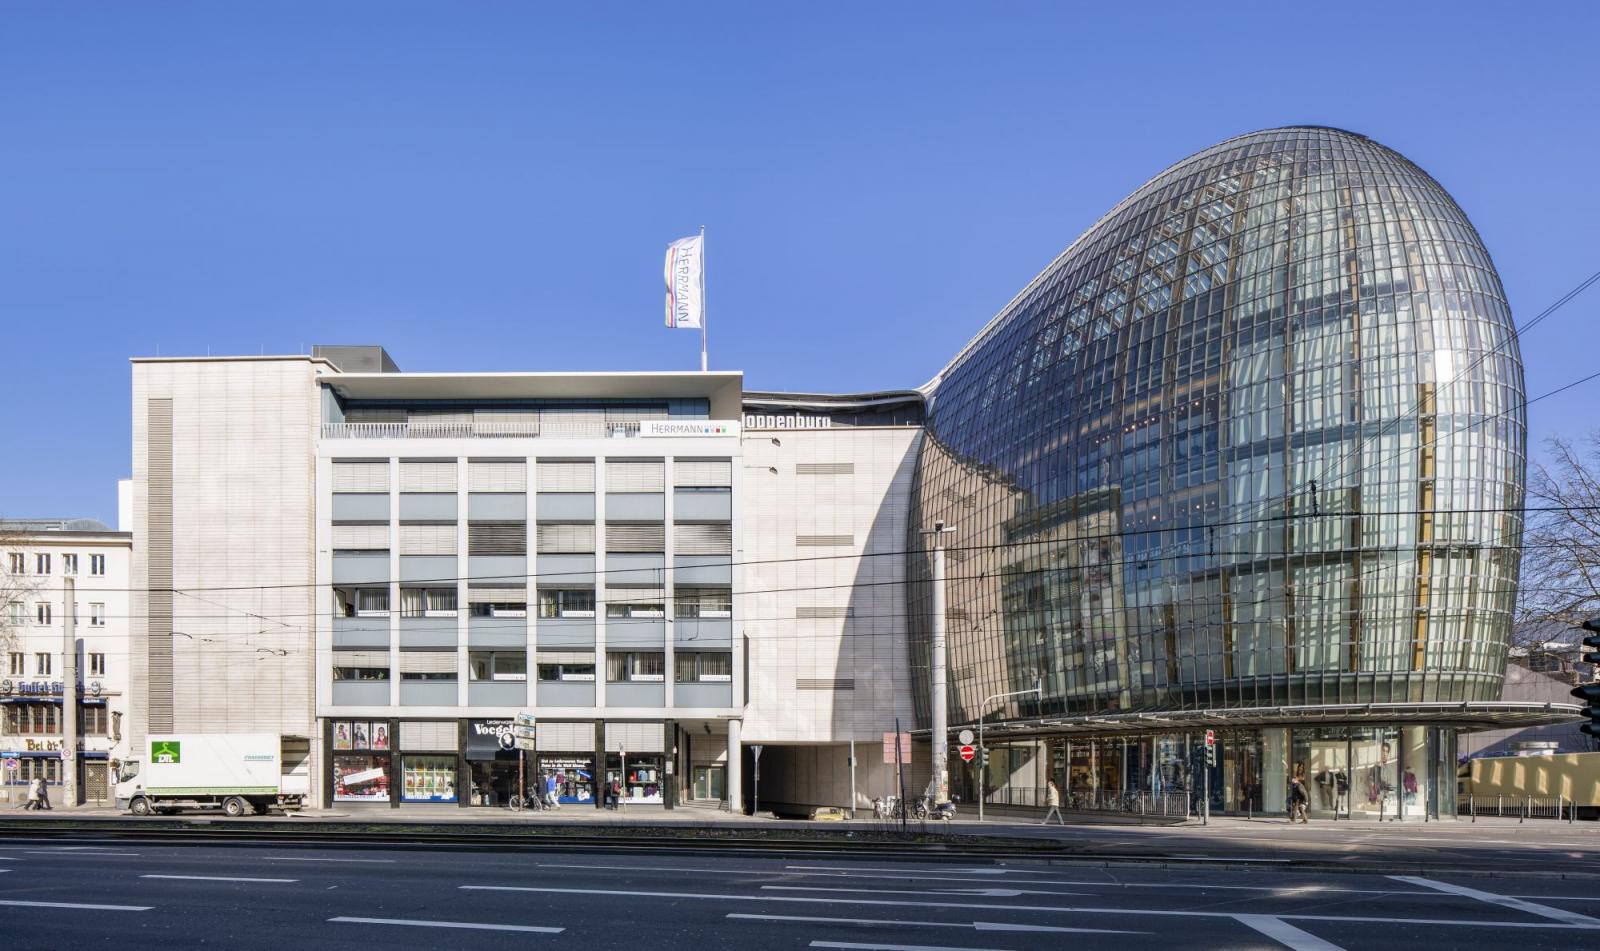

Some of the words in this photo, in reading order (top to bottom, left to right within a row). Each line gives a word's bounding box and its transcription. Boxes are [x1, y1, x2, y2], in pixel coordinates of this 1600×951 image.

[678, 246, 694, 322] HERRMANN
[741, 411, 831, 428] loppenburg
[651, 423, 703, 434] HERRMANN
[474, 723, 514, 738] Voegel
[25, 738, 44, 751] Bei
